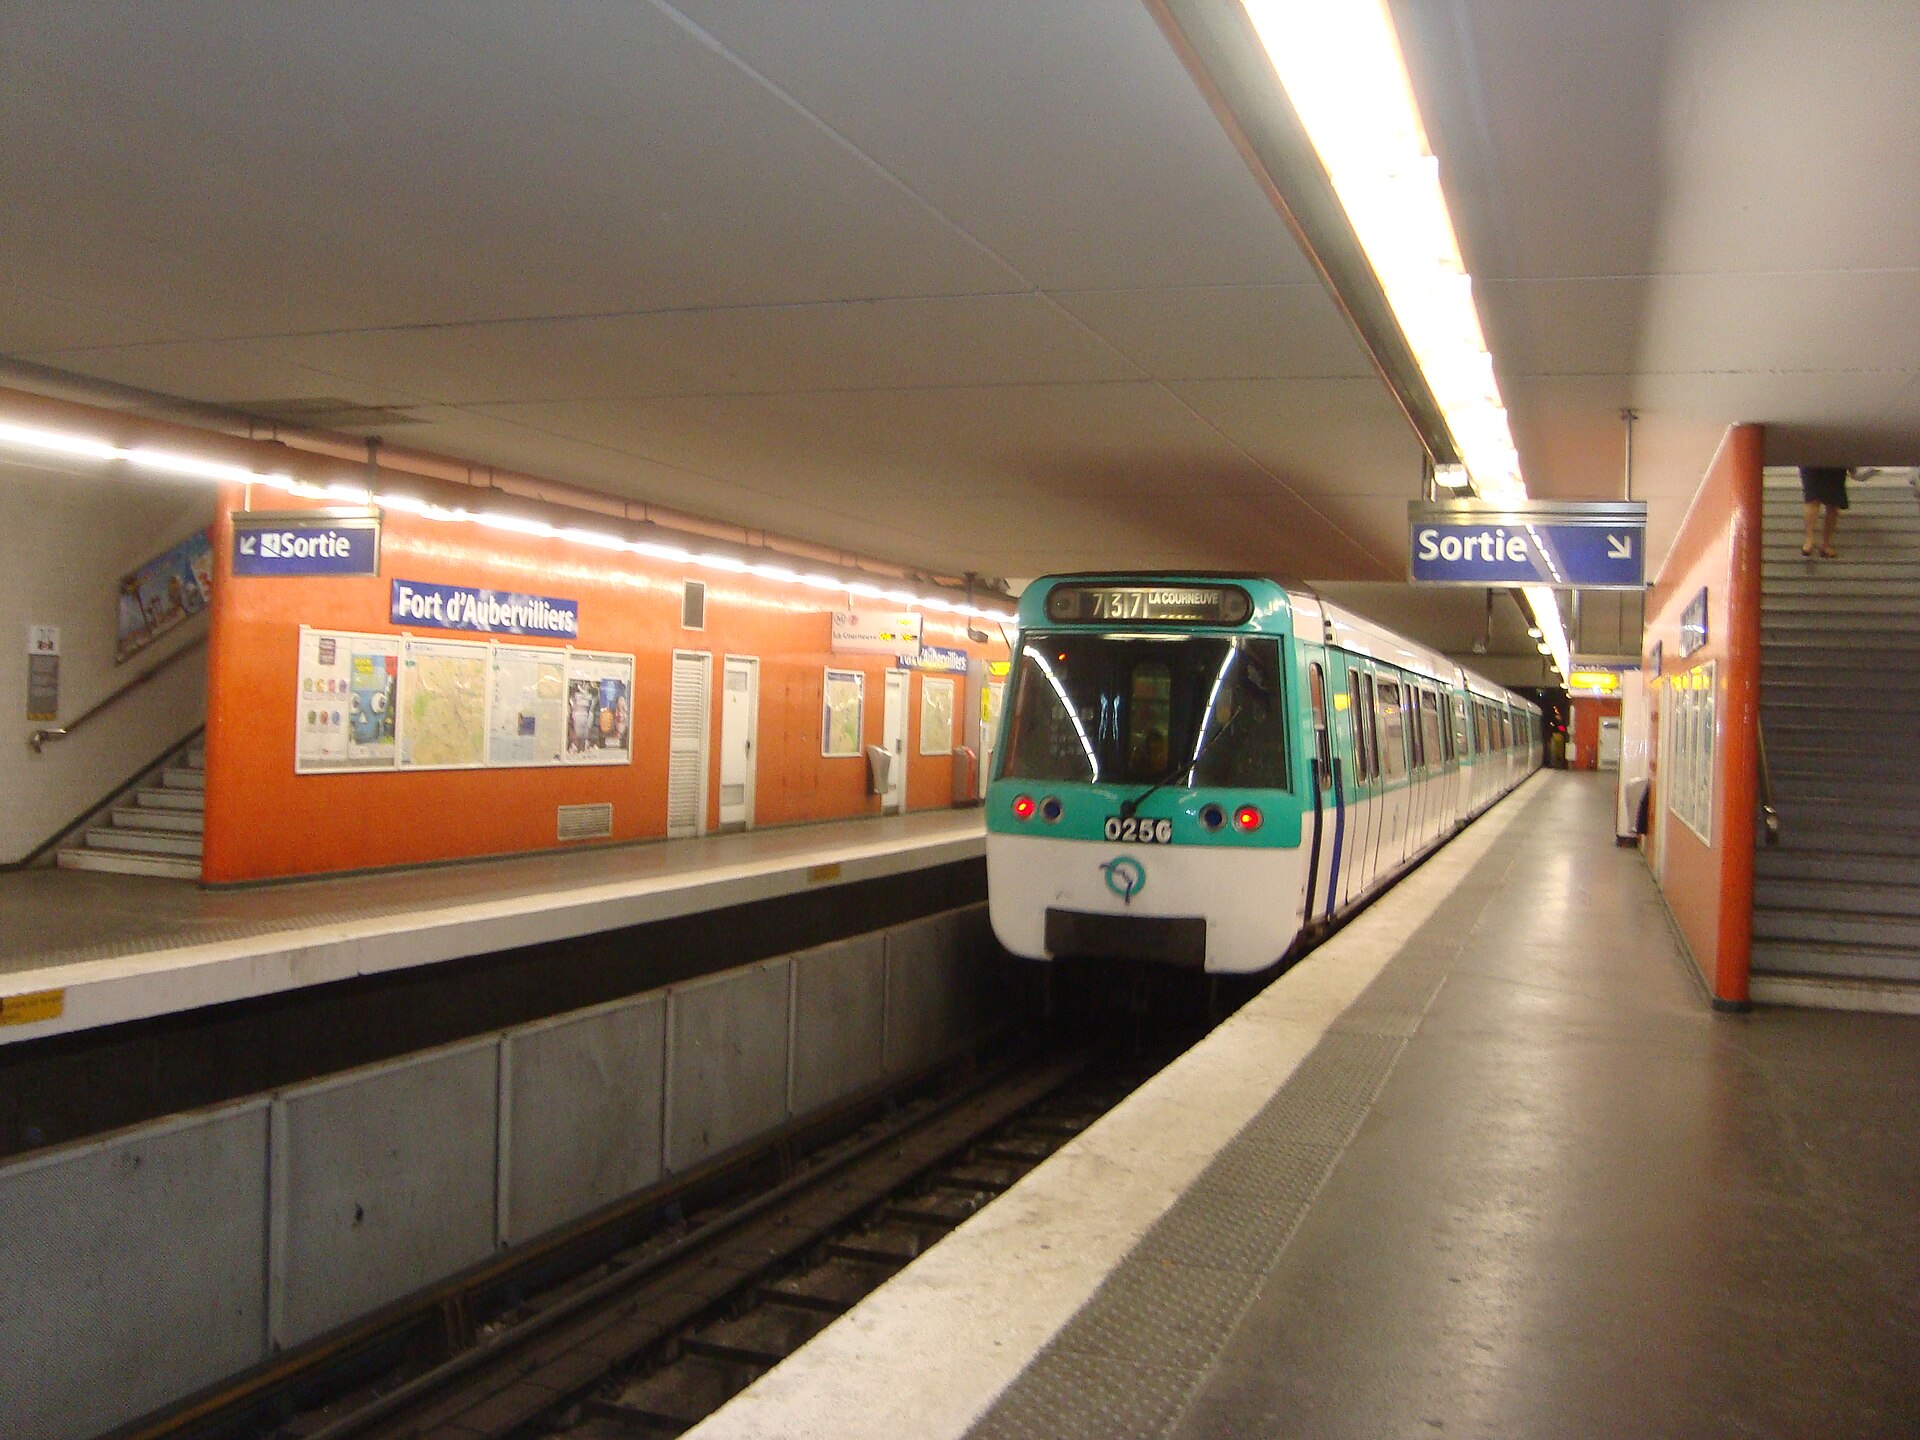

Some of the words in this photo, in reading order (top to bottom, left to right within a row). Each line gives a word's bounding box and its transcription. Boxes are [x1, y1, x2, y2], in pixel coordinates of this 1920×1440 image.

[280, 531, 351, 558] Sortie
[1418, 529, 1528, 562] Sortie
[399, 586, 442, 621] Fort
[446, 591, 575, 632] d'Aubervilliers
[1149, 593, 1161, 605] LA
[1104, 817, 1171, 843] 0256
